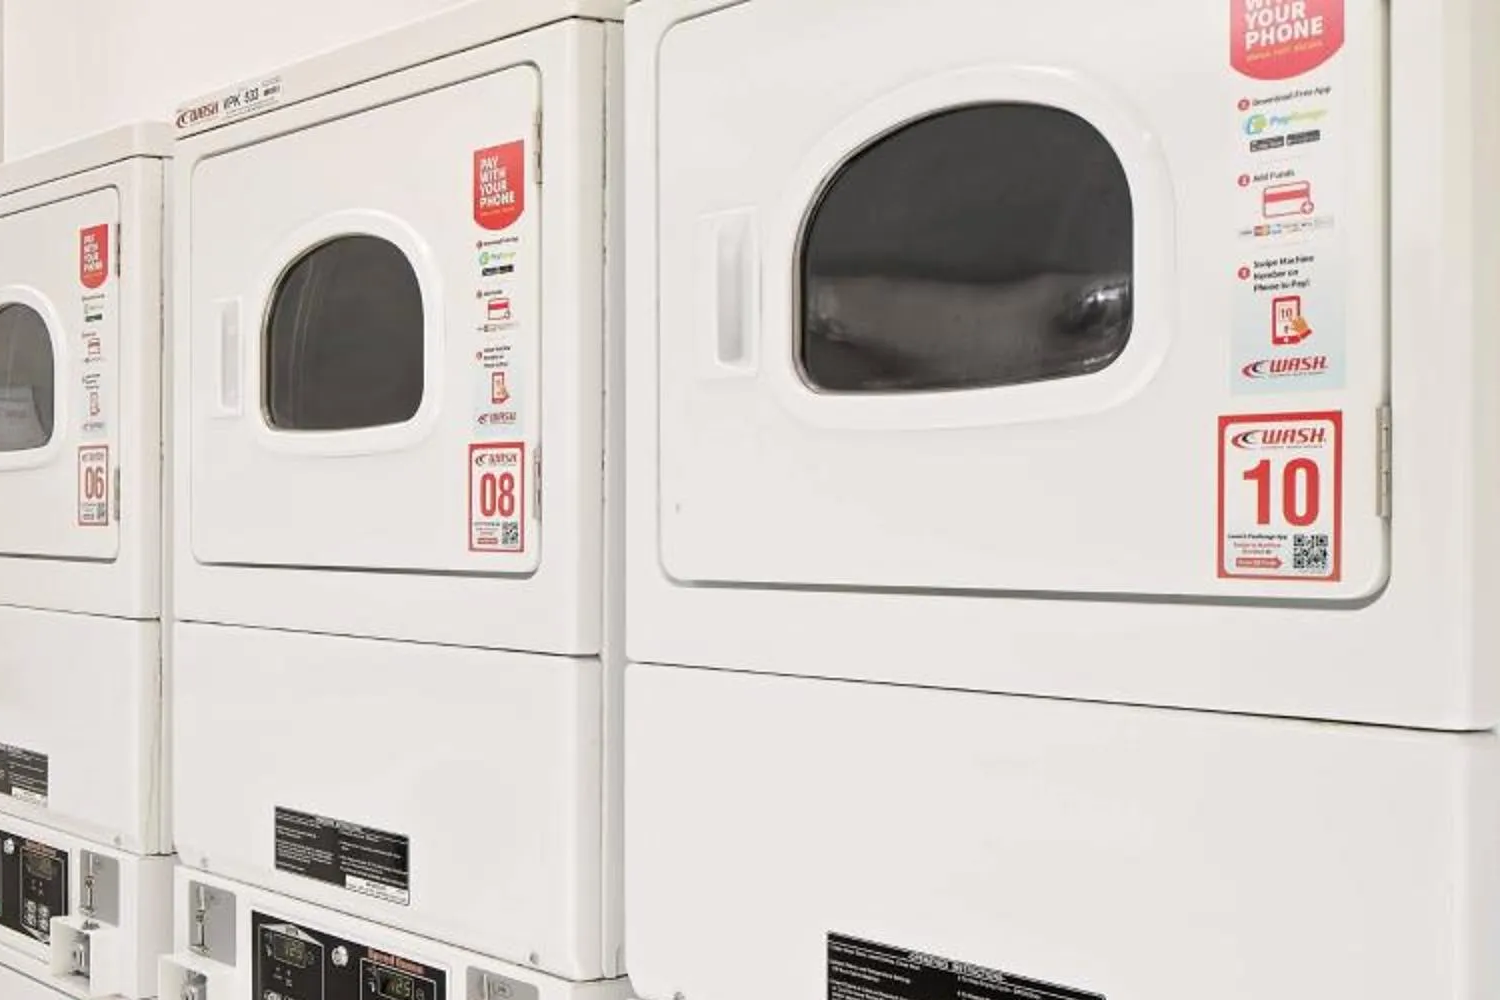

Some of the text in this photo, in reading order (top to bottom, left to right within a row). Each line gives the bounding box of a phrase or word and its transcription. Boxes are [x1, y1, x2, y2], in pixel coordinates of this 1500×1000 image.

[1245, 2, 1306, 30] YOUR
[1245, 16, 1324, 50] PHONE
[1270, 356, 1327, 373] WASH
[1262, 427, 1326, 444] WASH
[85, 466, 104, 499] 06
[480, 472, 515, 517] 08
[1243, 457, 1320, 526] 10
